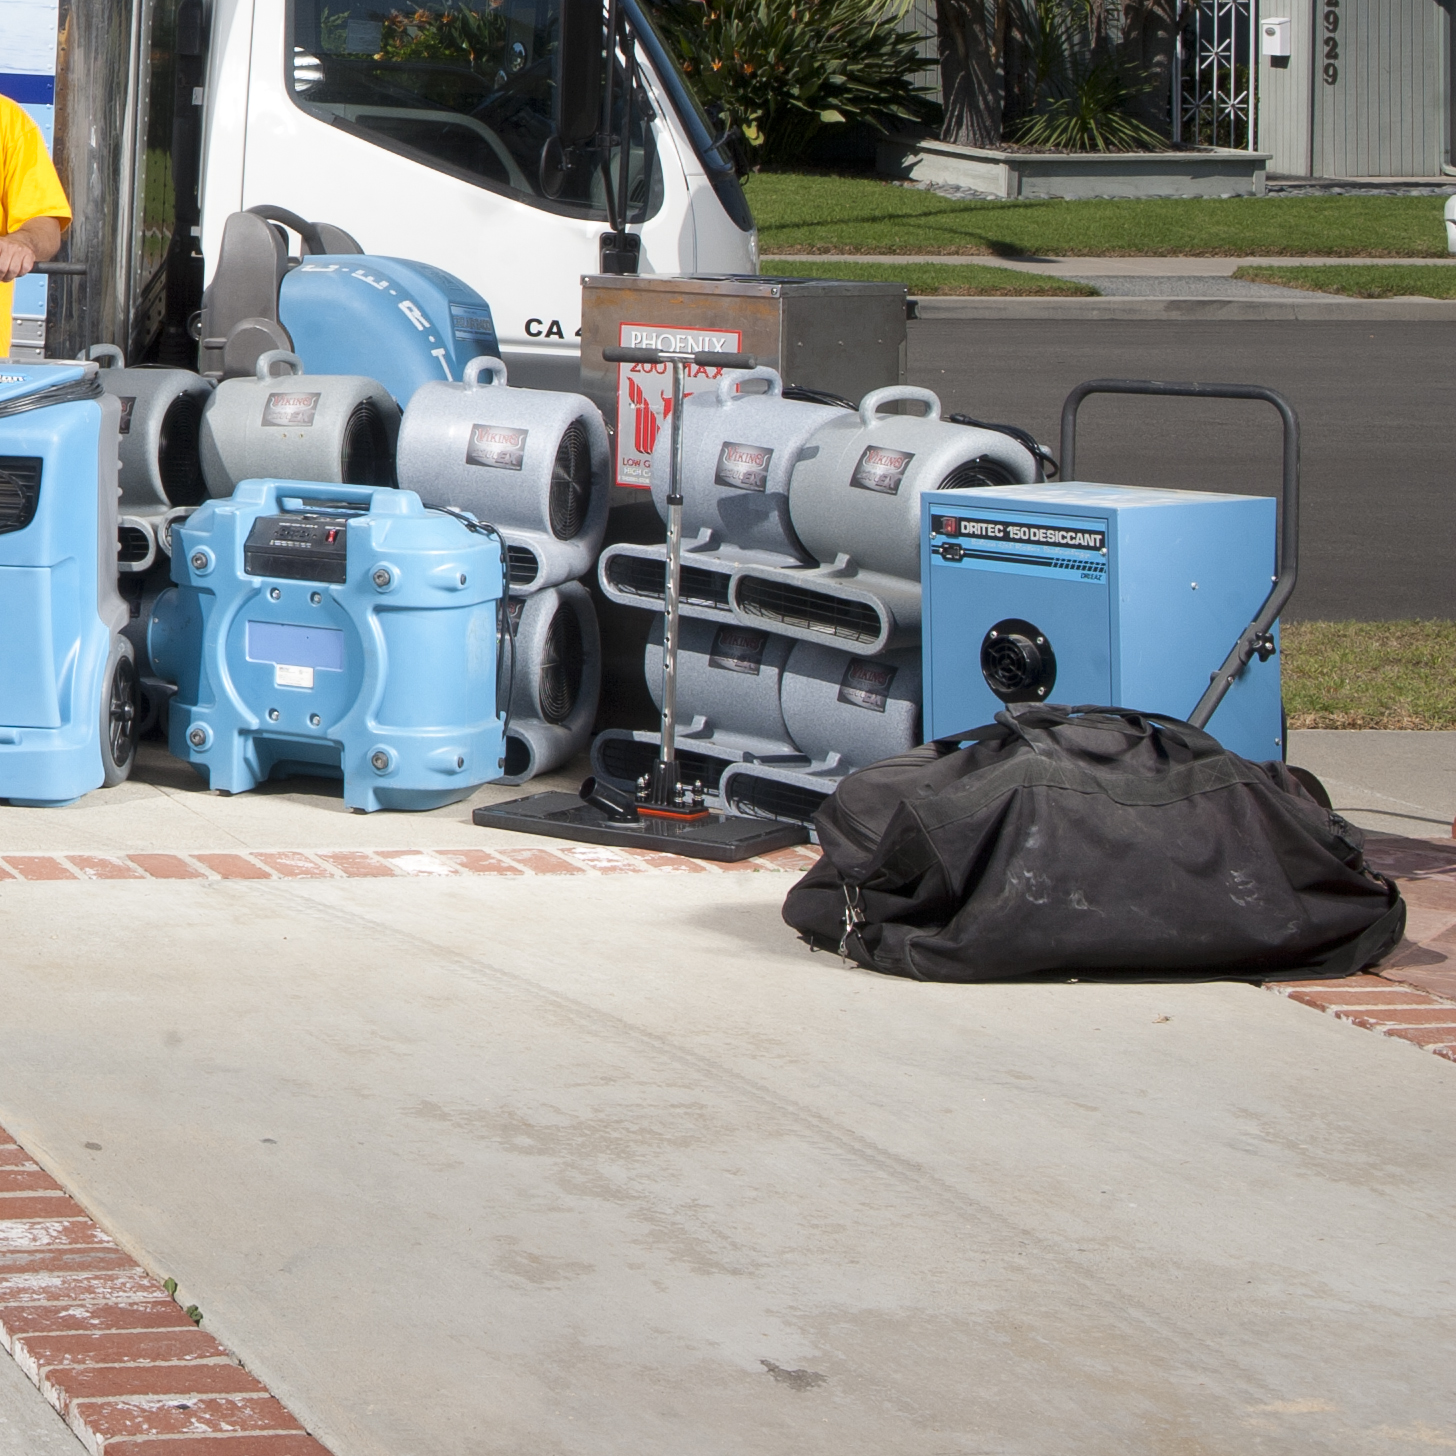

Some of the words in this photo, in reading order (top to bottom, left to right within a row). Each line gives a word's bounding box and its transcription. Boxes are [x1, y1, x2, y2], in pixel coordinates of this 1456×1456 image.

[524, 317, 565, 340] CA
[630, 330, 727, 353] PHOENIX
[960, 520, 1005, 538] DRITEC
[1006, 526, 1030, 541] 150
[1030, 530, 1103, 548] DESICCANT
